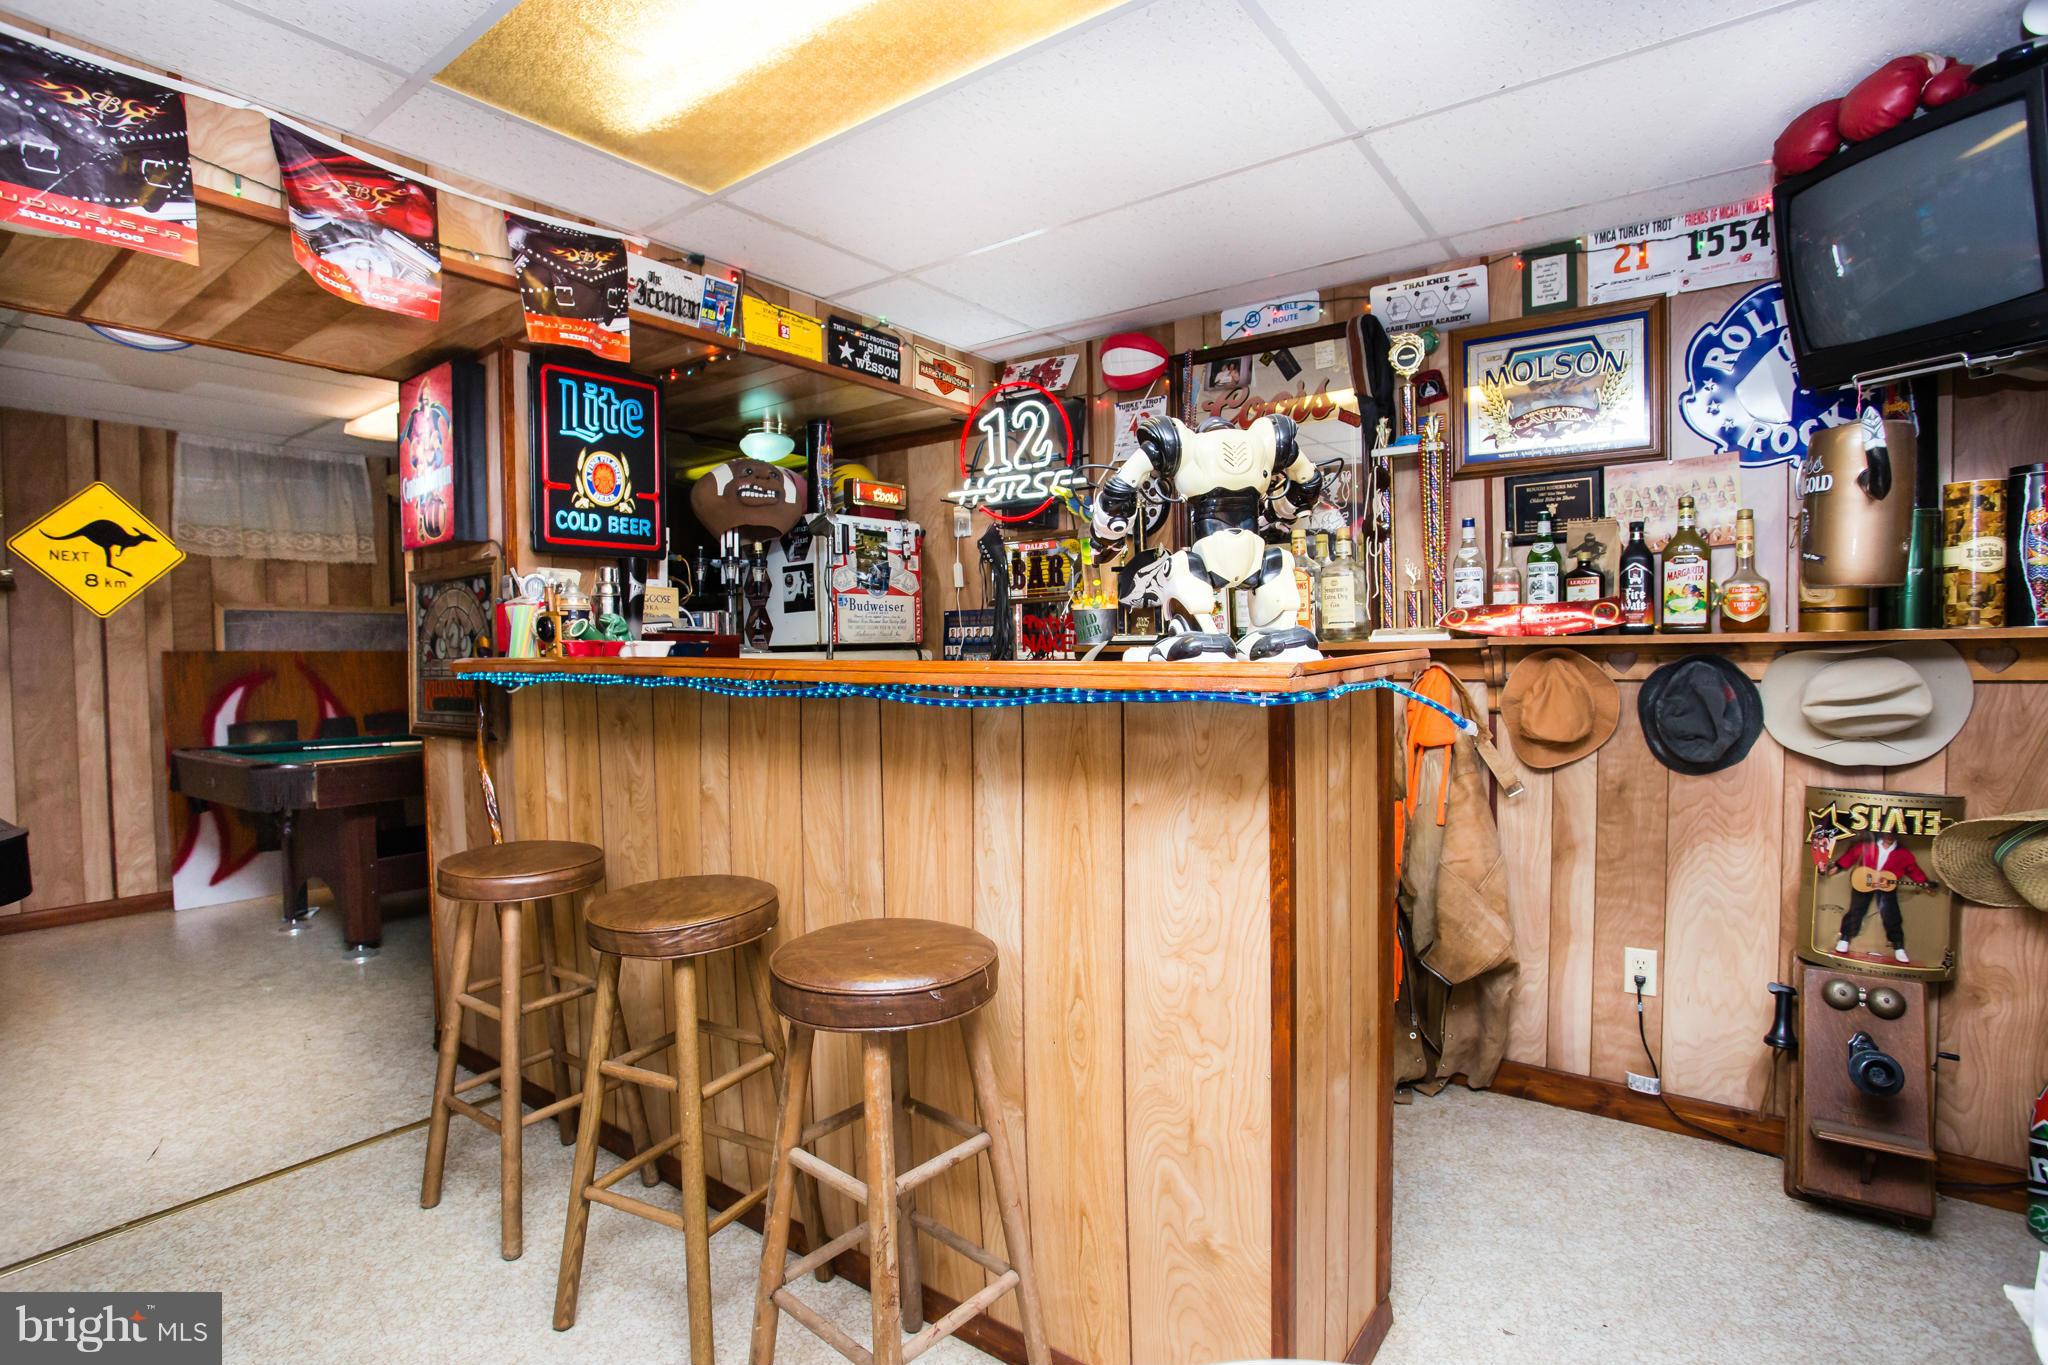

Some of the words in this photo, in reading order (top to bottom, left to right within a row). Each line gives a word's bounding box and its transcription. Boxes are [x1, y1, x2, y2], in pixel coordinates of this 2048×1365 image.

[0, 190, 182, 241] UDWEISER
[1685, 210, 1708, 227] FRIENDS
[1710, 207, 1718, 222] OF
[1594, 231, 1616, 245] YMCA
[1619, 223, 1649, 240] TURKEY
[1653, 218, 1672, 232] TROT
[1688, 217, 1771, 261] 1554
[1614, 240, 1649, 274] 21
[647, 270, 662, 286] The
[1403, 281, 1424, 290] THAI
[1426, 276, 1450, 286] KNEE
[1272, 313, 1298, 324] ROUTE
[1385, 324, 1403, 333] CAGE
[1405, 320, 1433, 330] FIGHTER
[1435, 313, 1472, 325] ACADEMY
[833, 323, 846, 331] THIS
[847, 327, 869, 340] VECLE
[869, 335, 898, 349] PROTECTED
[1702, 299, 1790, 375] ROLL
[863, 351, 870, 360] &
[867, 343, 898, 361] SMITH
[855, 357, 899, 379] WESSON
[1484, 349, 1628, 391] MOLSON
[558, 378, 645, 443] Lite
[1202, 378, 1336, 430] Coors
[1523, 407, 1560, 420] IMPORTED
[1515, 411, 1591, 431] CANADA
[979, 400, 1053, 475] 12
[873, 487, 899, 504] Coors
[555, 509, 602, 532] COLD
[608, 515, 651, 537] BEER
[49, 550, 89, 562] NEXT
[1025, 541, 1049, 551] DALE'S
[85, 573, 99, 587] 8
[104, 578, 127, 588] km
[1012, 554, 1066, 591] BAR
[1667, 566, 1705, 582] MARGARITA
[1625, 587, 1646, 599] Fire
[849, 598, 905, 612] Budweiser
[1850, 803, 1942, 835] ELVIS
